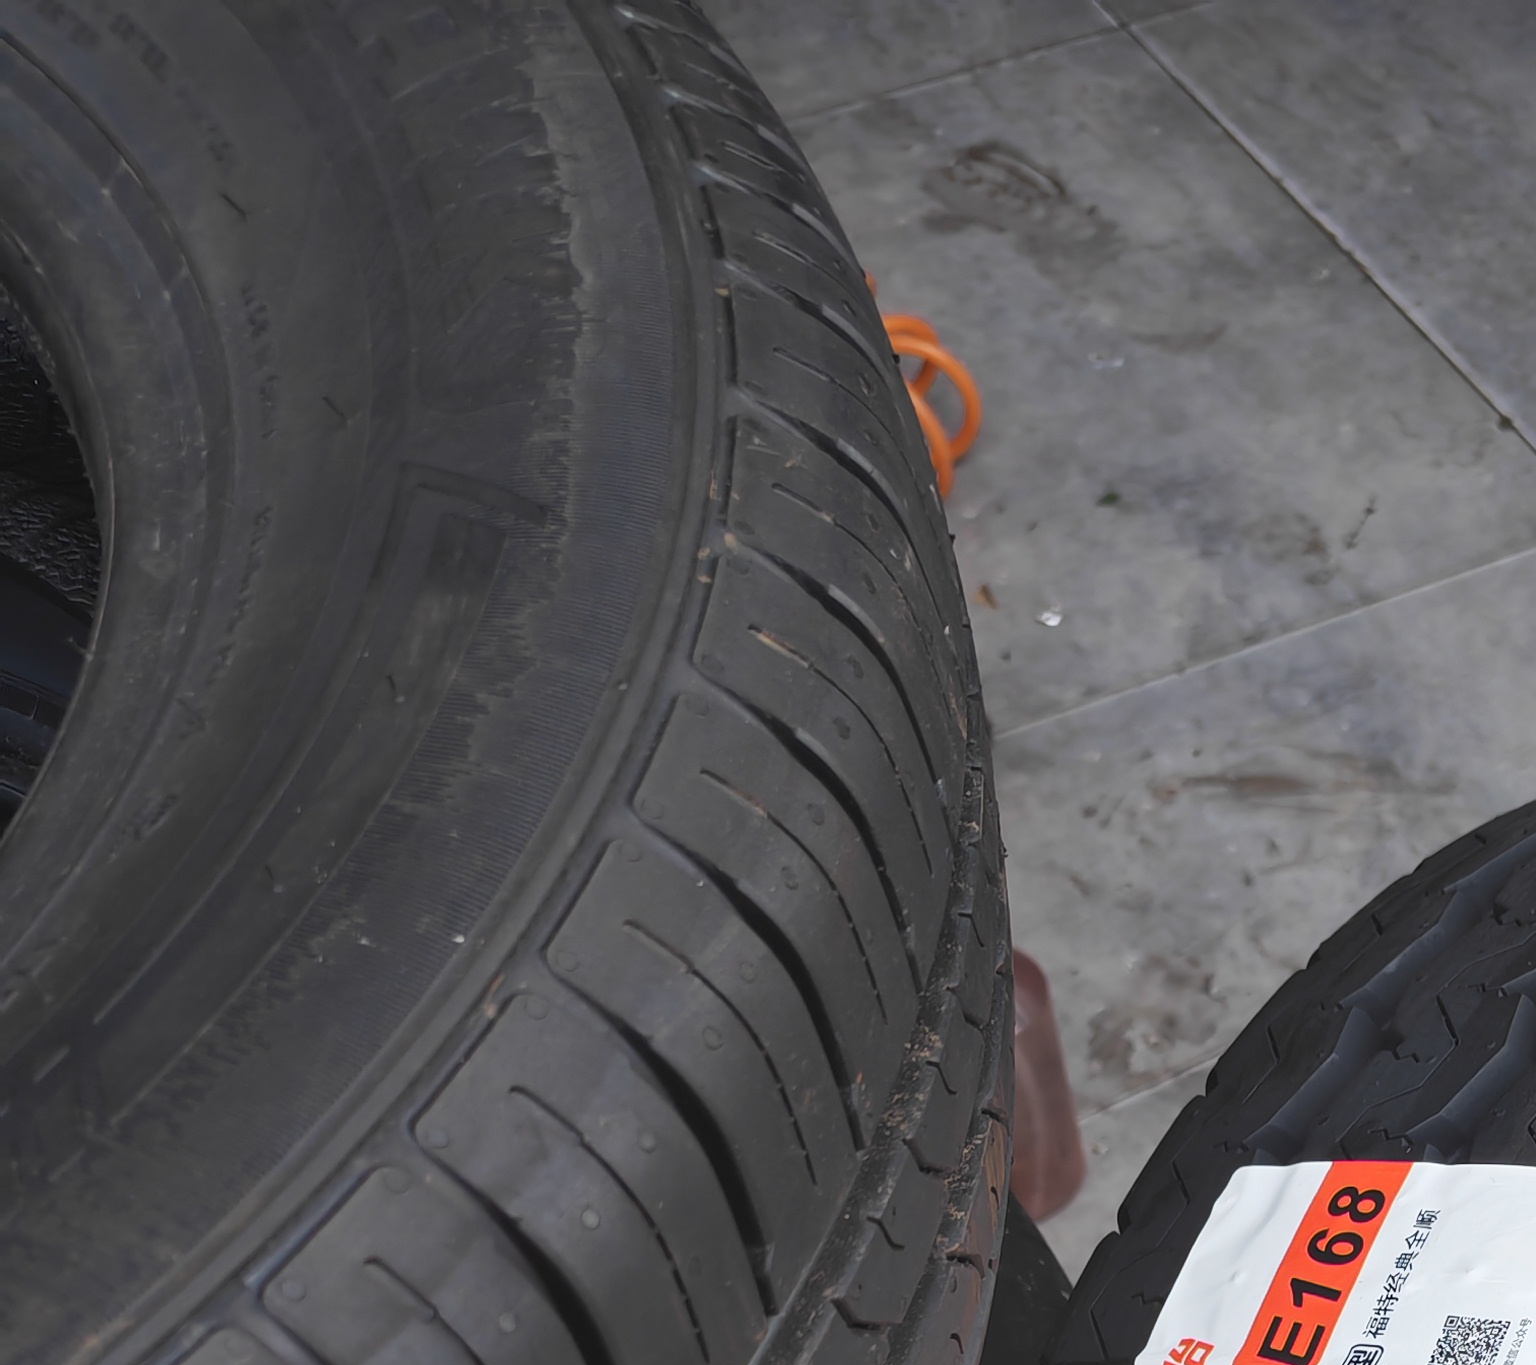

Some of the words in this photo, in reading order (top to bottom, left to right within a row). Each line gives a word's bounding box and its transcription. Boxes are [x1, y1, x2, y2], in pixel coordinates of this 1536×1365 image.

[1360, 1207, 1441, 1339] 福特经典全顺
